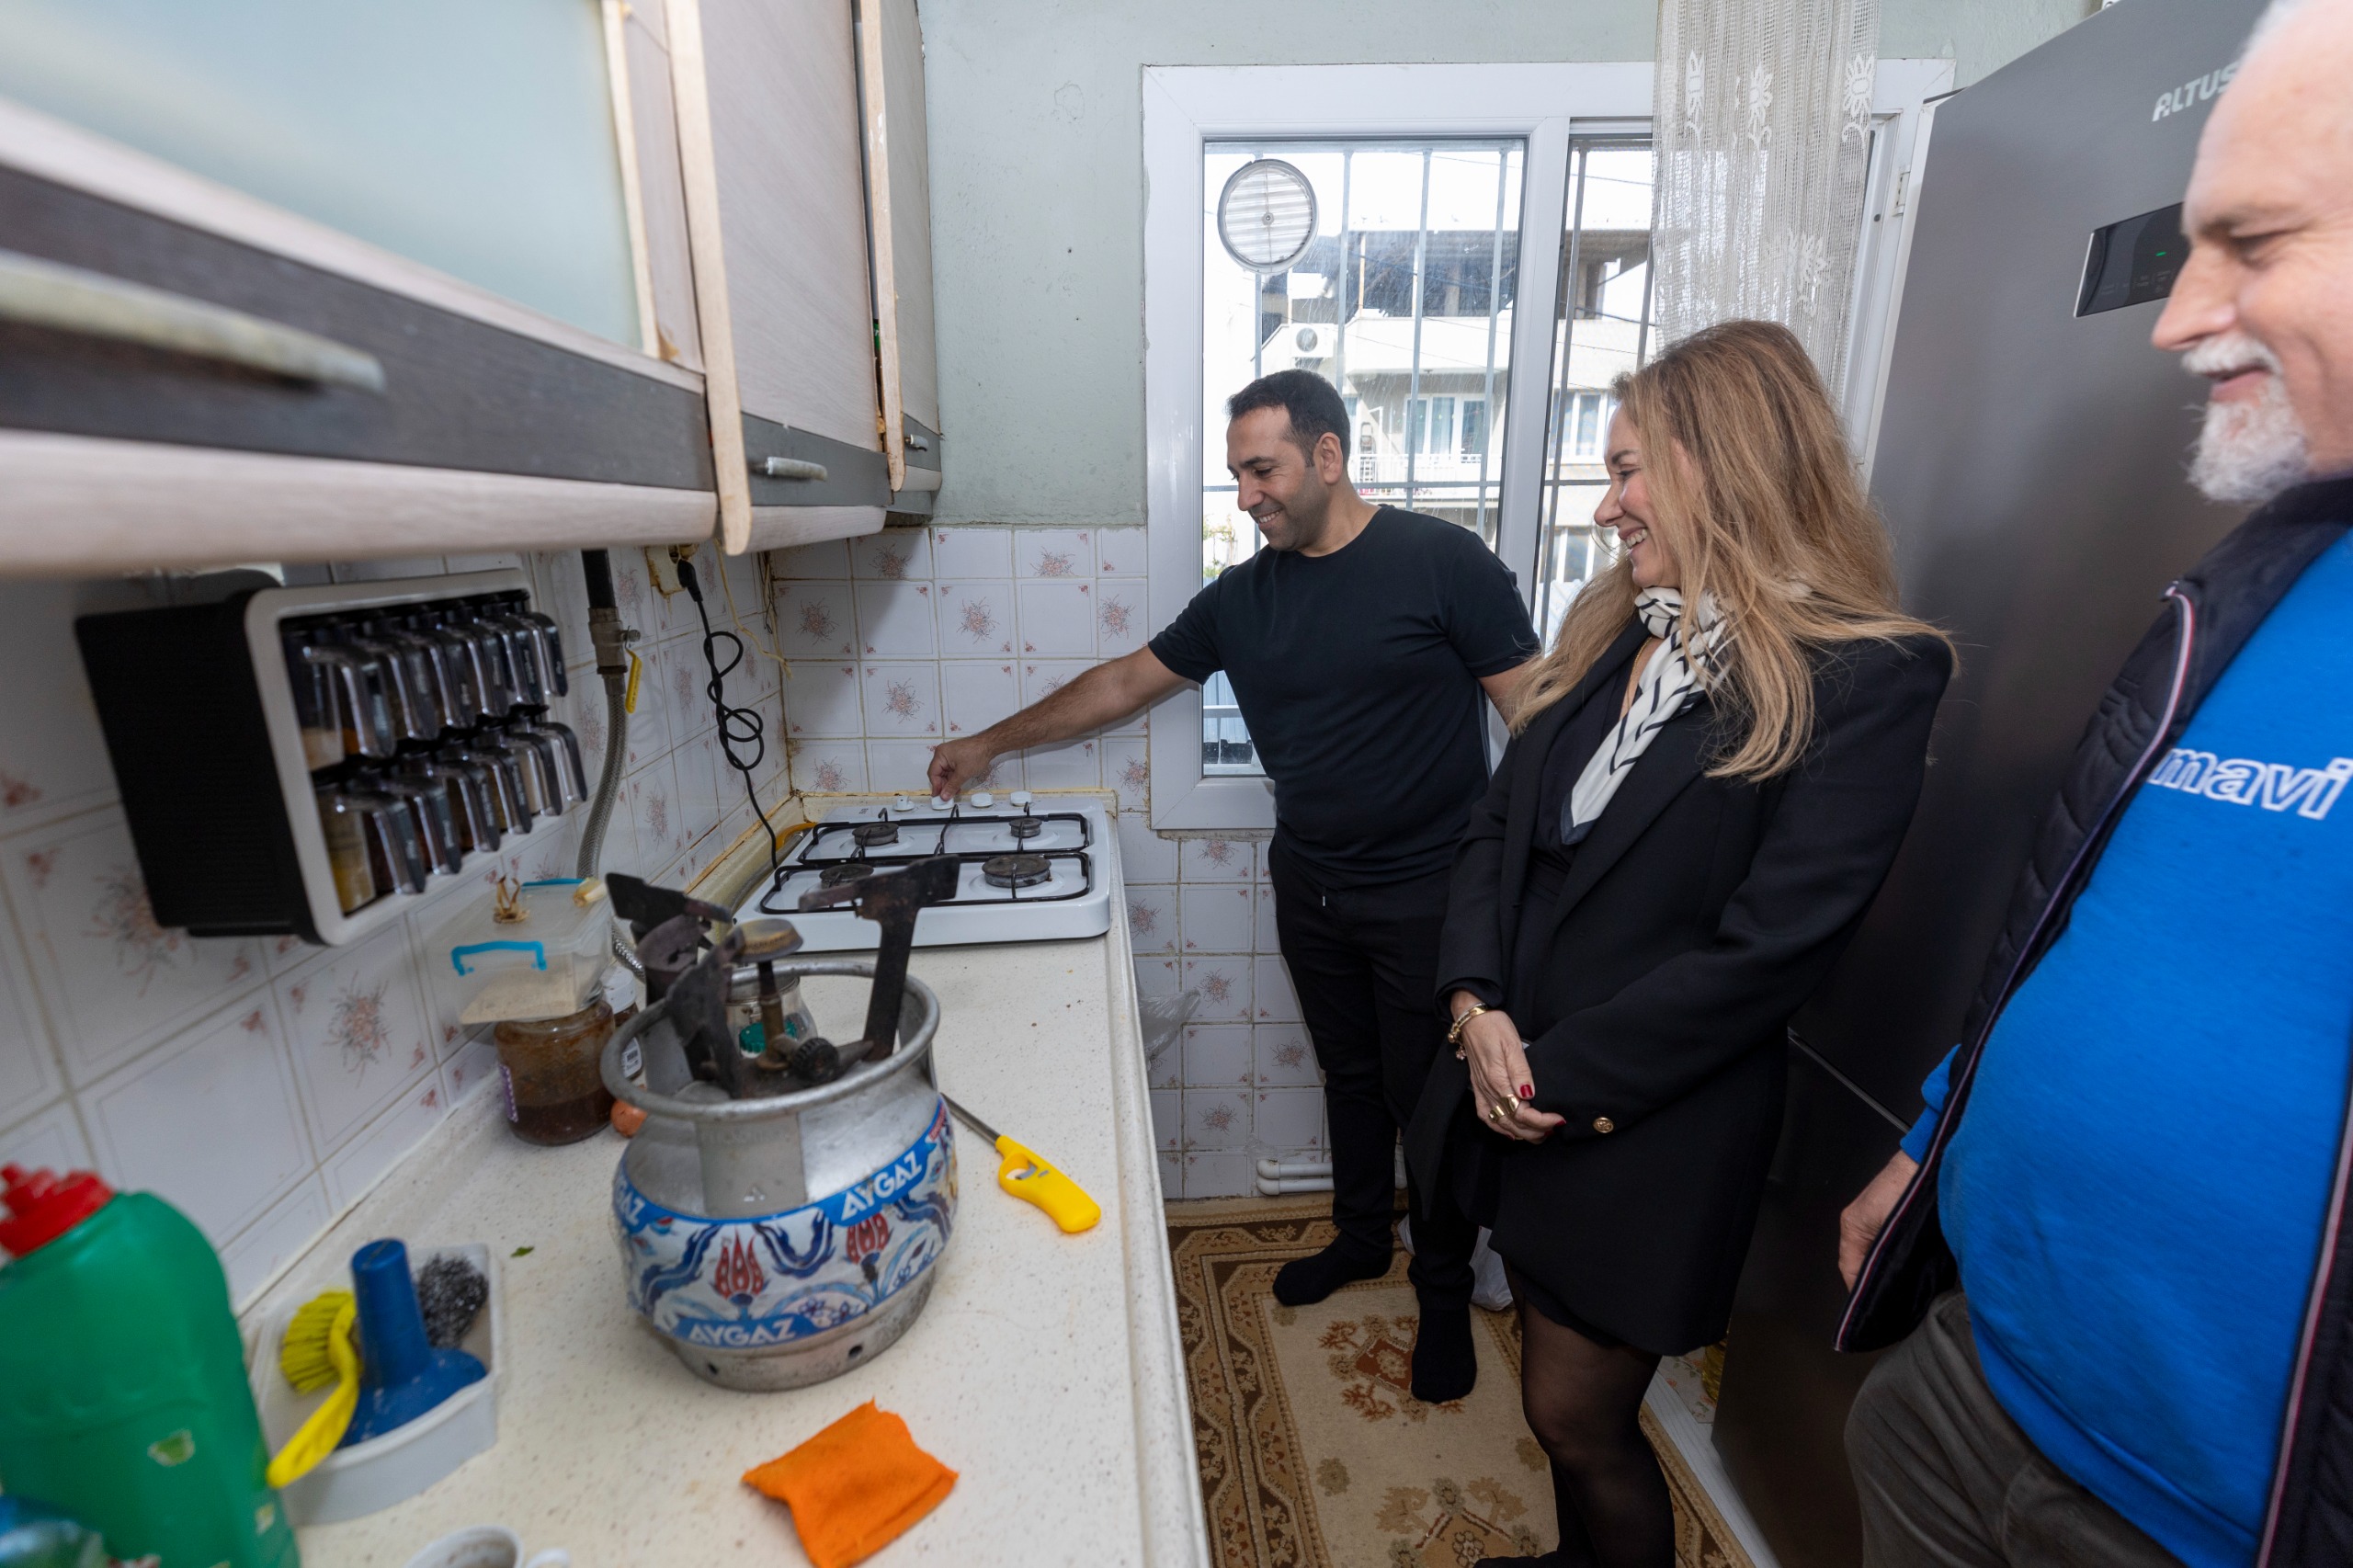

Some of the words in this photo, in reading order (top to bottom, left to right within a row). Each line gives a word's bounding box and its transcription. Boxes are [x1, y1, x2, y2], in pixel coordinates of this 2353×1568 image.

[2152, 62, 2238, 122] ALTUS
[2148, 748, 2353, 820] mavi
[615, 1171, 646, 1226] GAZ
[840, 1151, 923, 1221] AYGAZ
[688, 1318, 797, 1346] AYGAZ
